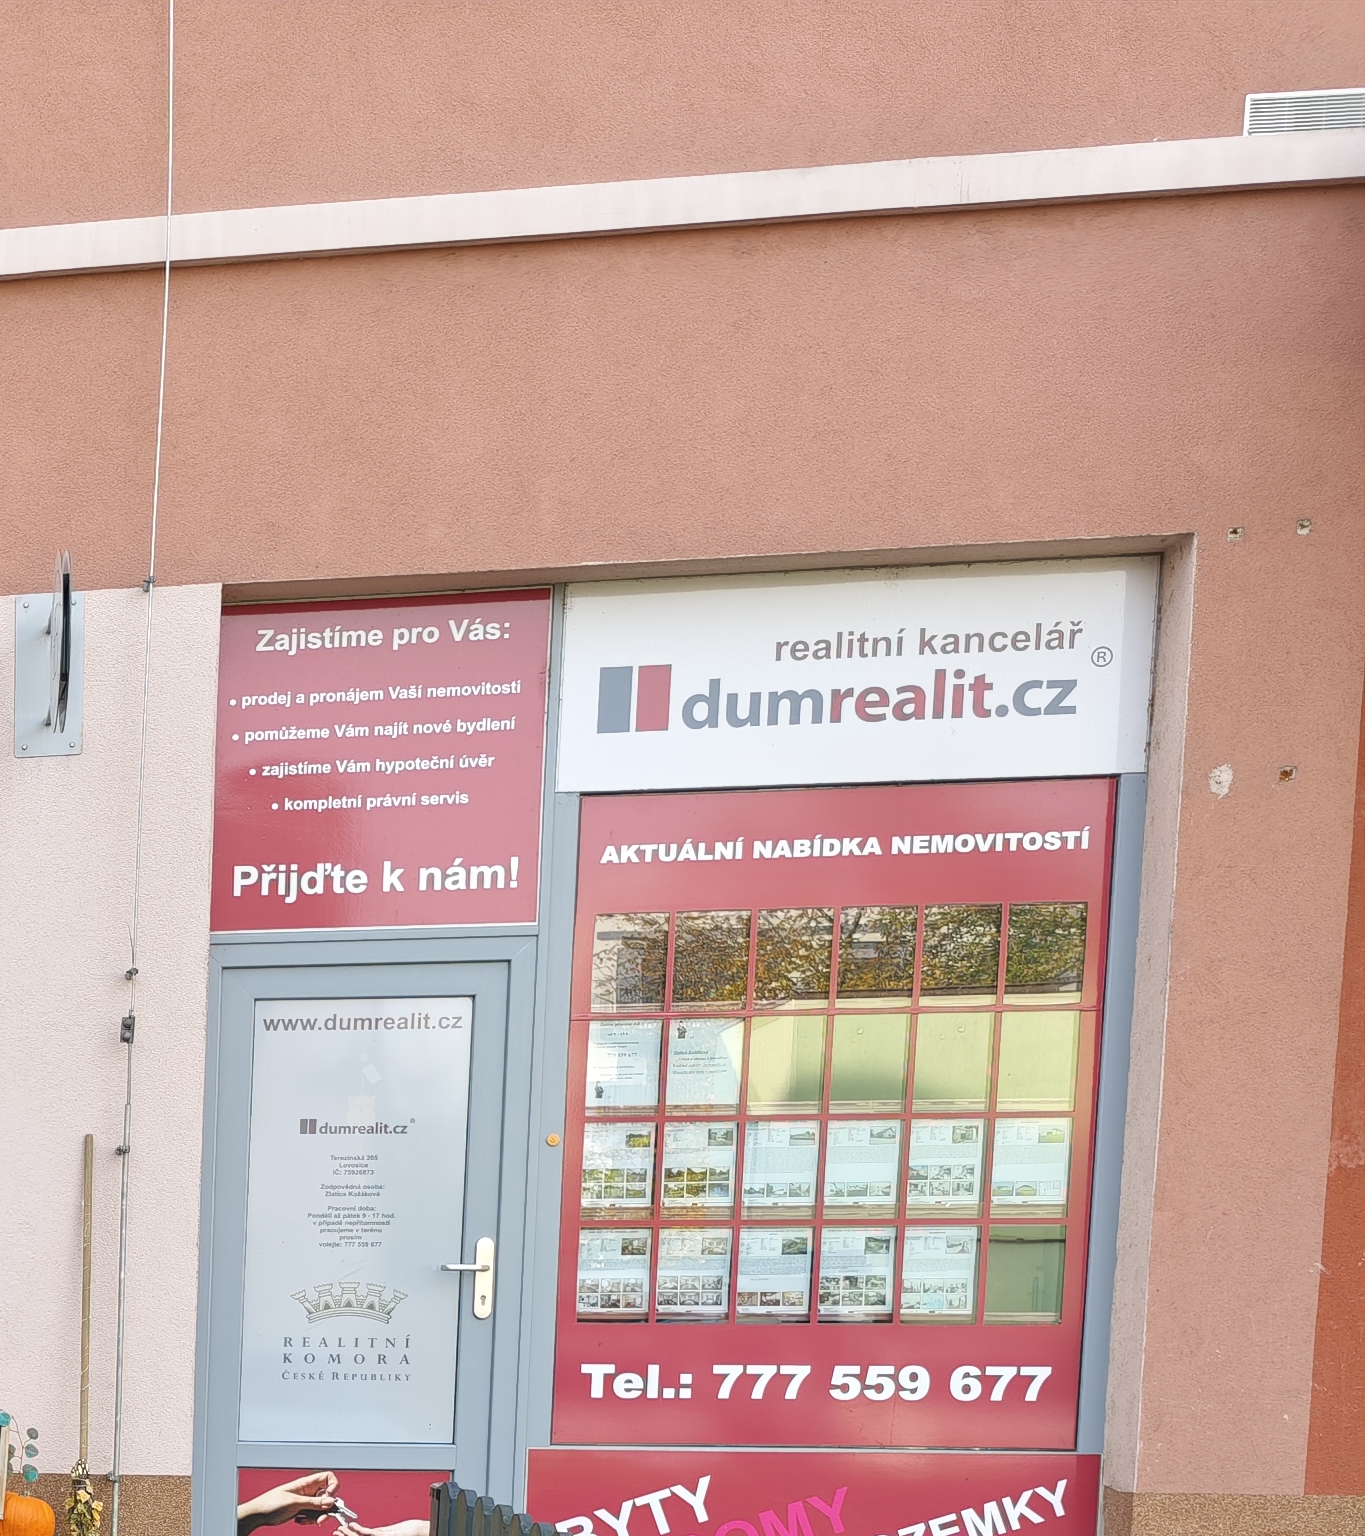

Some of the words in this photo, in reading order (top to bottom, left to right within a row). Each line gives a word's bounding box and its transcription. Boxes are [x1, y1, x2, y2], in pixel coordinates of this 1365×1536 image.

[255, 625, 383, 656] Zajistíme
[392, 625, 439, 650] pro
[448, 618, 511, 642] Vás:
[775, 629, 904, 662] realitní
[918, 621, 1083, 656] kancelář
[242, 691, 291, 709] prodej
[296, 693, 305, 704] a
[309, 686, 383, 706] pronájem
[388, 685, 422, 699] Vaší
[427, 681, 521, 697] nemovitosti
[681, 668, 1078, 730] dumrealit.cz
[244, 726, 330, 744] pomůžeme
[334, 724, 369, 738] Vám
[374, 721, 409, 739] najít
[413, 719, 452, 734] nové
[456, 716, 516, 735] bydlení
[261, 760, 331, 778] zajistíme
[335, 758, 371, 773] Vám
[375, 754, 454, 774] hypoteční
[459, 754, 495, 767] úvěr
[284, 795, 361, 812] kompletní
[366, 793, 416, 811] právní
[420, 791, 469, 806] servis
[599, 836, 744, 864] AKTUÁLNÍ
[752, 833, 882, 859] NABÍDKA
[891, 826, 1091, 854] NEMOVITOSTÍ
[233, 862, 368, 903] Přijďte
[382, 860, 405, 893] k
[418, 856, 519, 892] nám!
[263, 1012, 463, 1032] www.dumrealit.cz
[319, 1122, 408, 1135] dumrealit.cz
[283, 1334, 411, 1348] REALITNÍ
[283, 1353, 411, 1364] KOMORA
[581, 1364, 693, 1399] Tel.:
[712, 1364, 811, 1400] 777
[829, 1365, 930, 1400] 559
[949, 1366, 1053, 1402] 677
